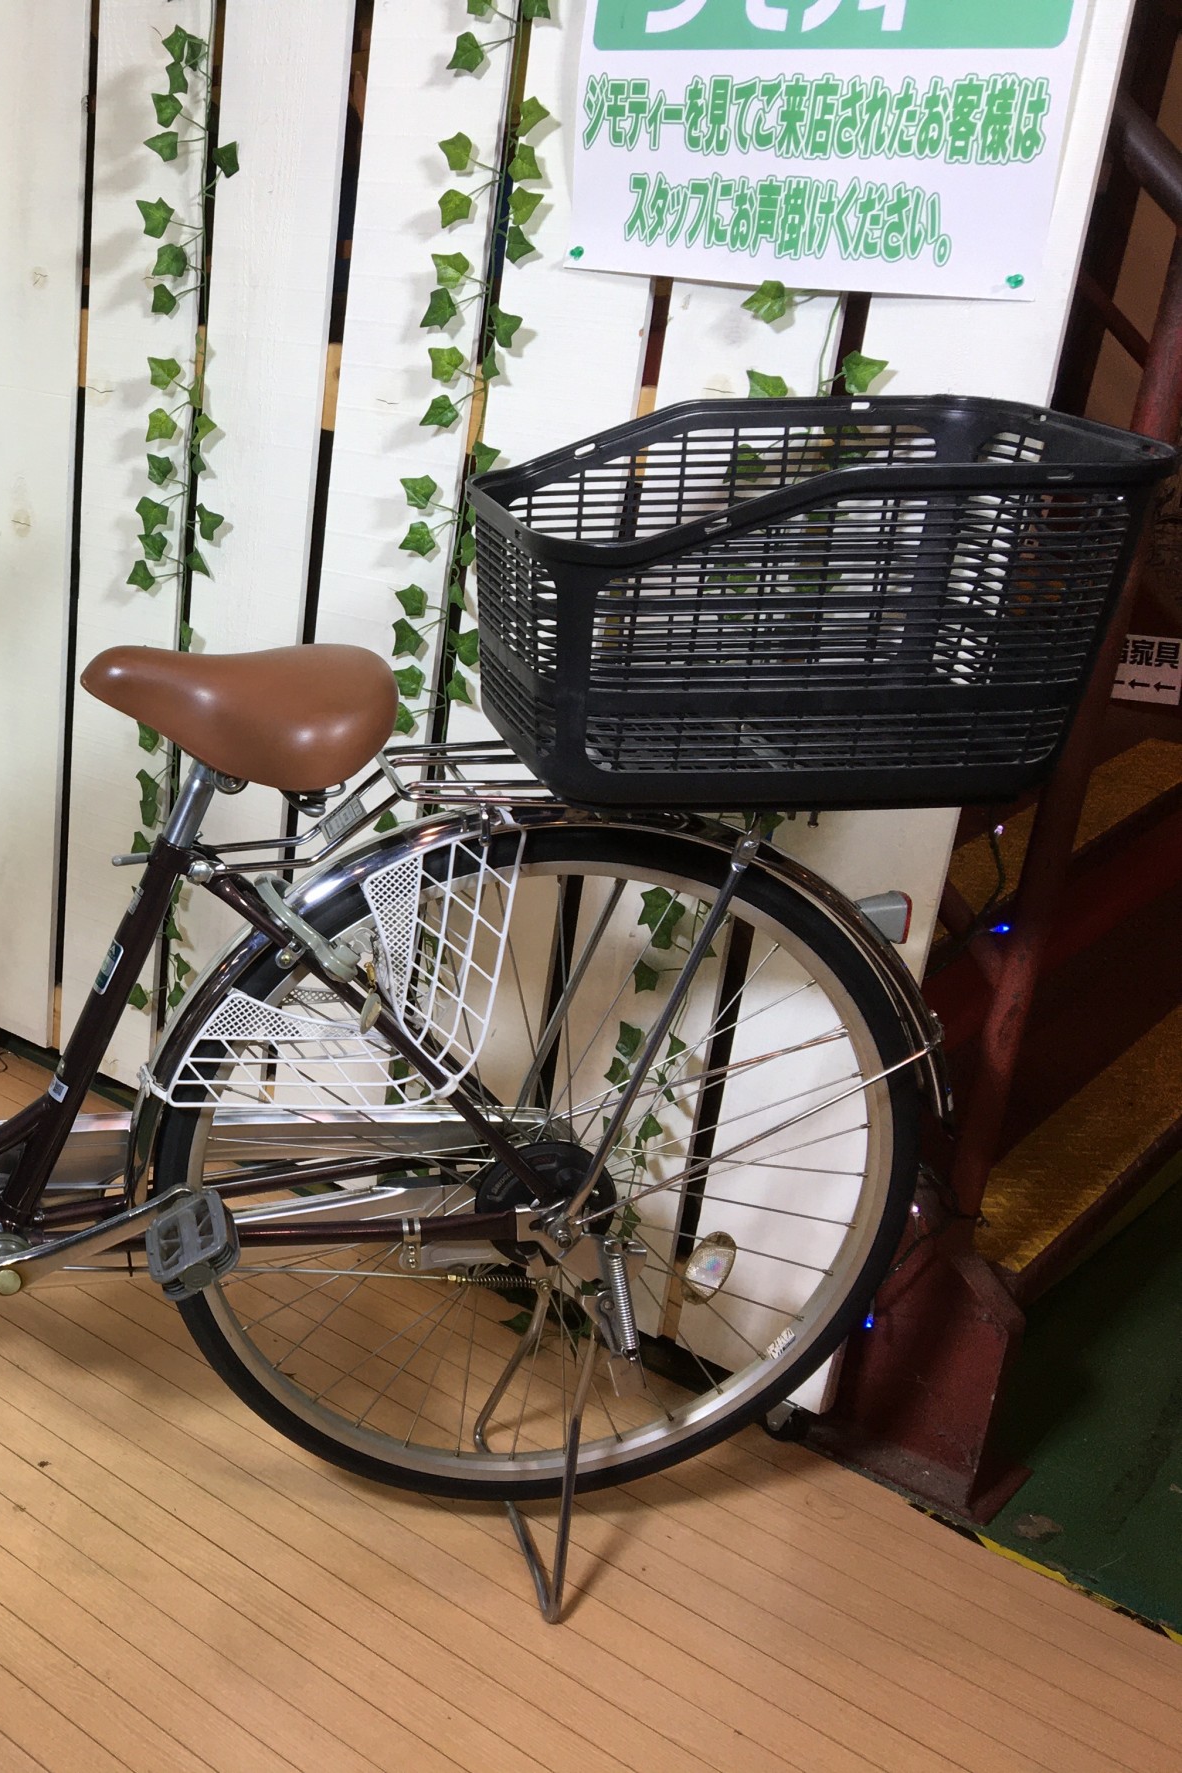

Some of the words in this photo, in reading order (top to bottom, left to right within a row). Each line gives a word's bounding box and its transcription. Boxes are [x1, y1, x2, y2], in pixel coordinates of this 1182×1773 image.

[582, 73, 1051, 165] ジモティーを見てご来店されたお客様は
[624, 172, 952, 267] スタッフにお声掛けください。
